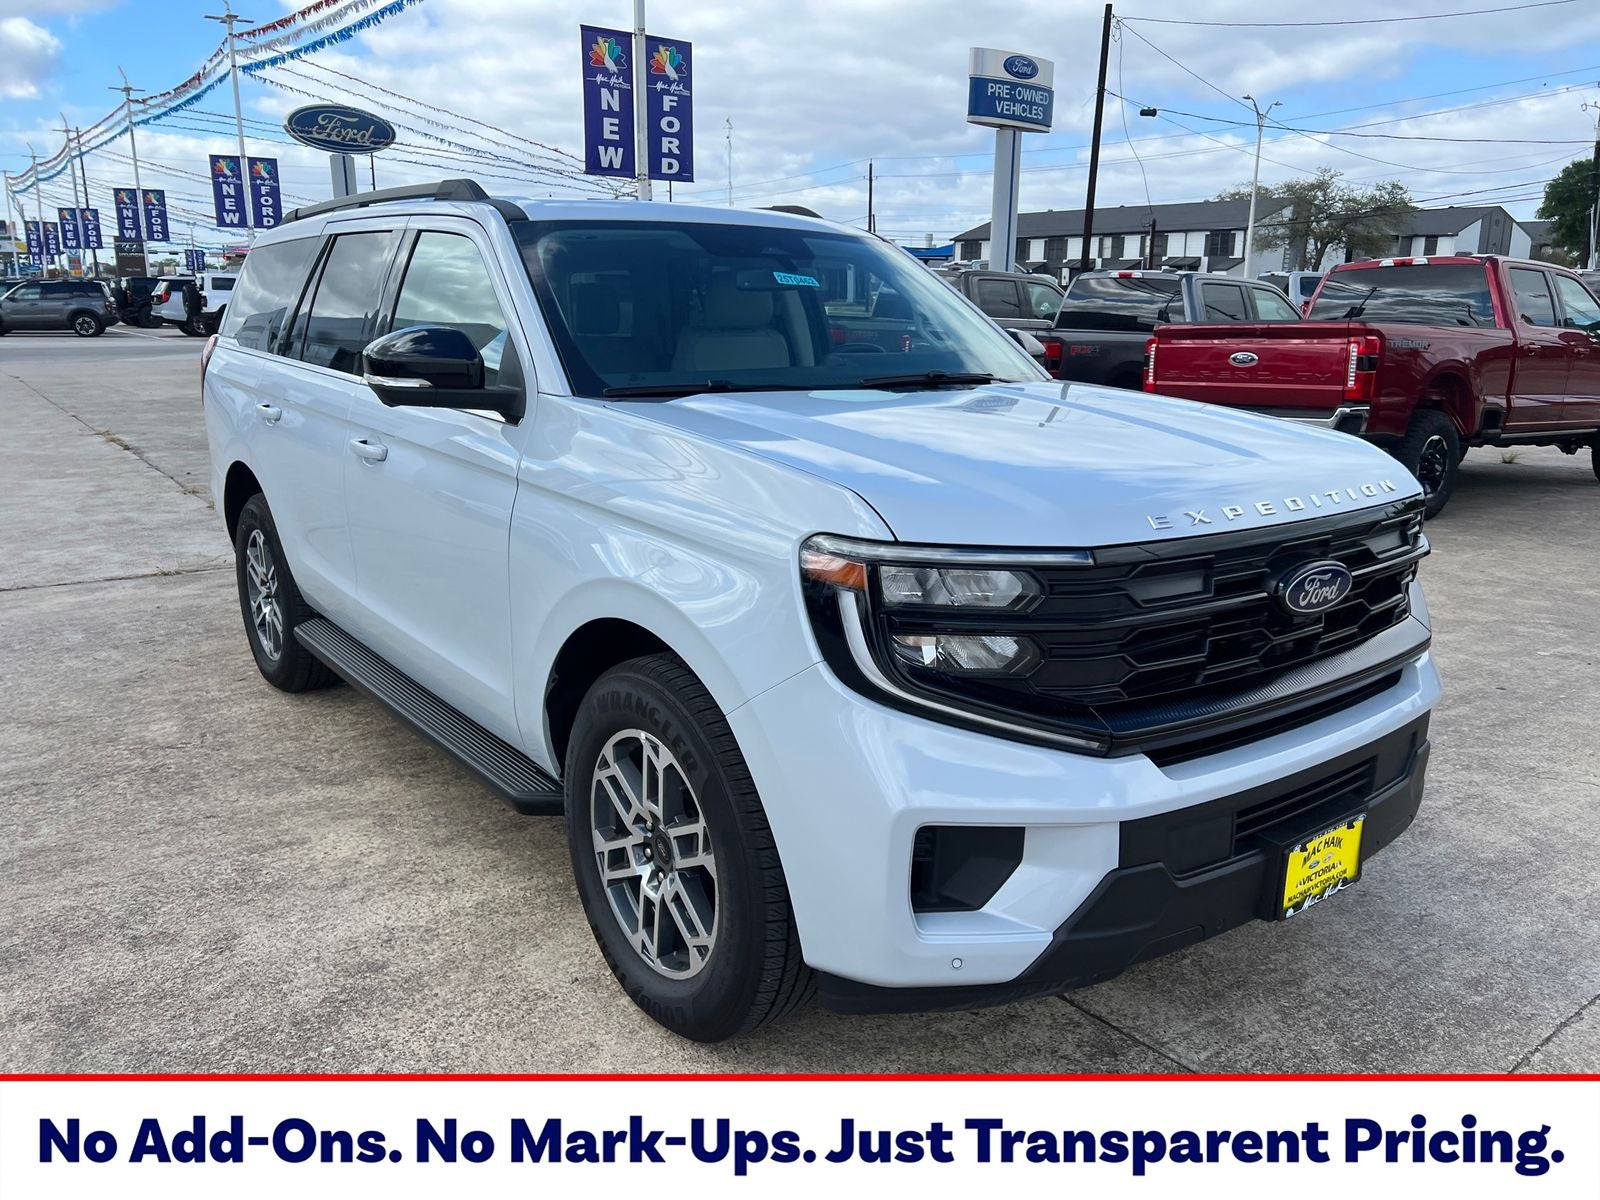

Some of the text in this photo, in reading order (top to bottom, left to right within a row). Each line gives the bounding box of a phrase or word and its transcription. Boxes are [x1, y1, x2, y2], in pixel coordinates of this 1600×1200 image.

[1012, 58, 1033, 75] Ford
[995, 100, 1044, 120] VEHICLES
[311, 113, 375, 144] Ford
[598, 87, 624, 169] NEW
[660, 95, 681, 175] FORD
[221, 183, 240, 224] NEW
[260, 185, 275, 226] FORD
[65, 223, 77, 247] NEW
[87, 224, 98, 248] FORD
[122, 208, 136, 238] NEW
[151, 209, 163, 240] FORD
[29, 233, 40, 253] NEW
[48, 234, 57, 254] FORD
[1390, 339, 1429, 349] TREMOR
[1147, 479, 1398, 530] EXPEDITION
[1299, 571, 1342, 607] Ford
[593, 690, 699, 772] WRANGLER
[1301, 836, 1343, 868] MAC HAIK
